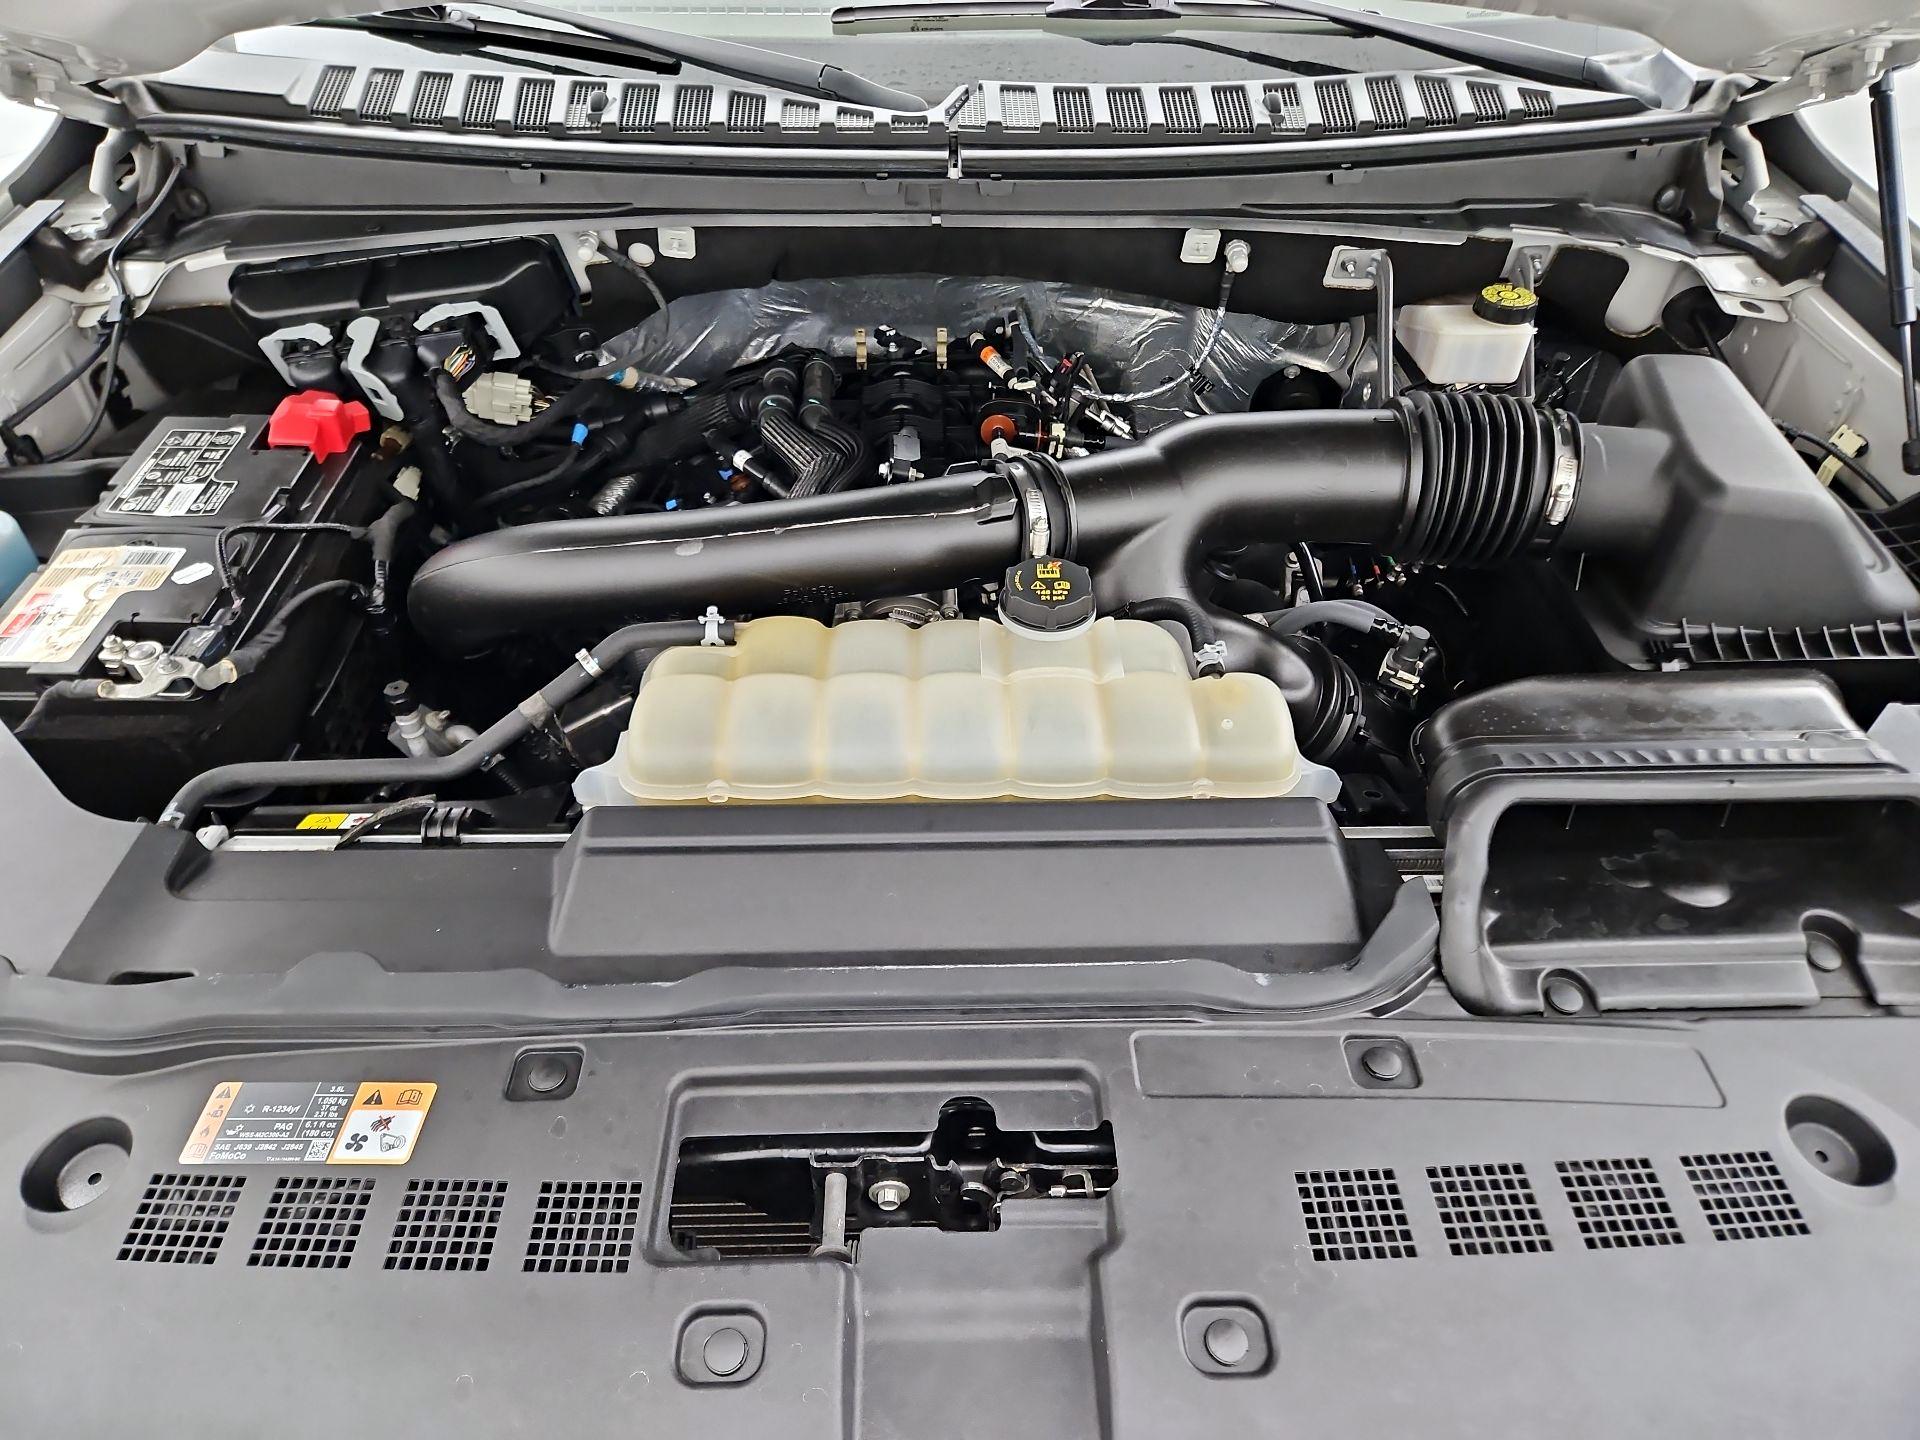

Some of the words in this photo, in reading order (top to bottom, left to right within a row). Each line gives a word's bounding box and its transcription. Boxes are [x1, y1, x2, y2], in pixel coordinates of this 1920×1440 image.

[317, 1097, 337, 1105] 1.050
[338, 1097, 349, 1106] kg
[262, 1105, 301, 1114] R-1234yf
[273, 1122, 293, 1130] PAG
[301, 1130, 320, 1138] (180
[320, 1130, 334, 1138] cc)
[208, 1152, 246, 1160] FoMoCo
